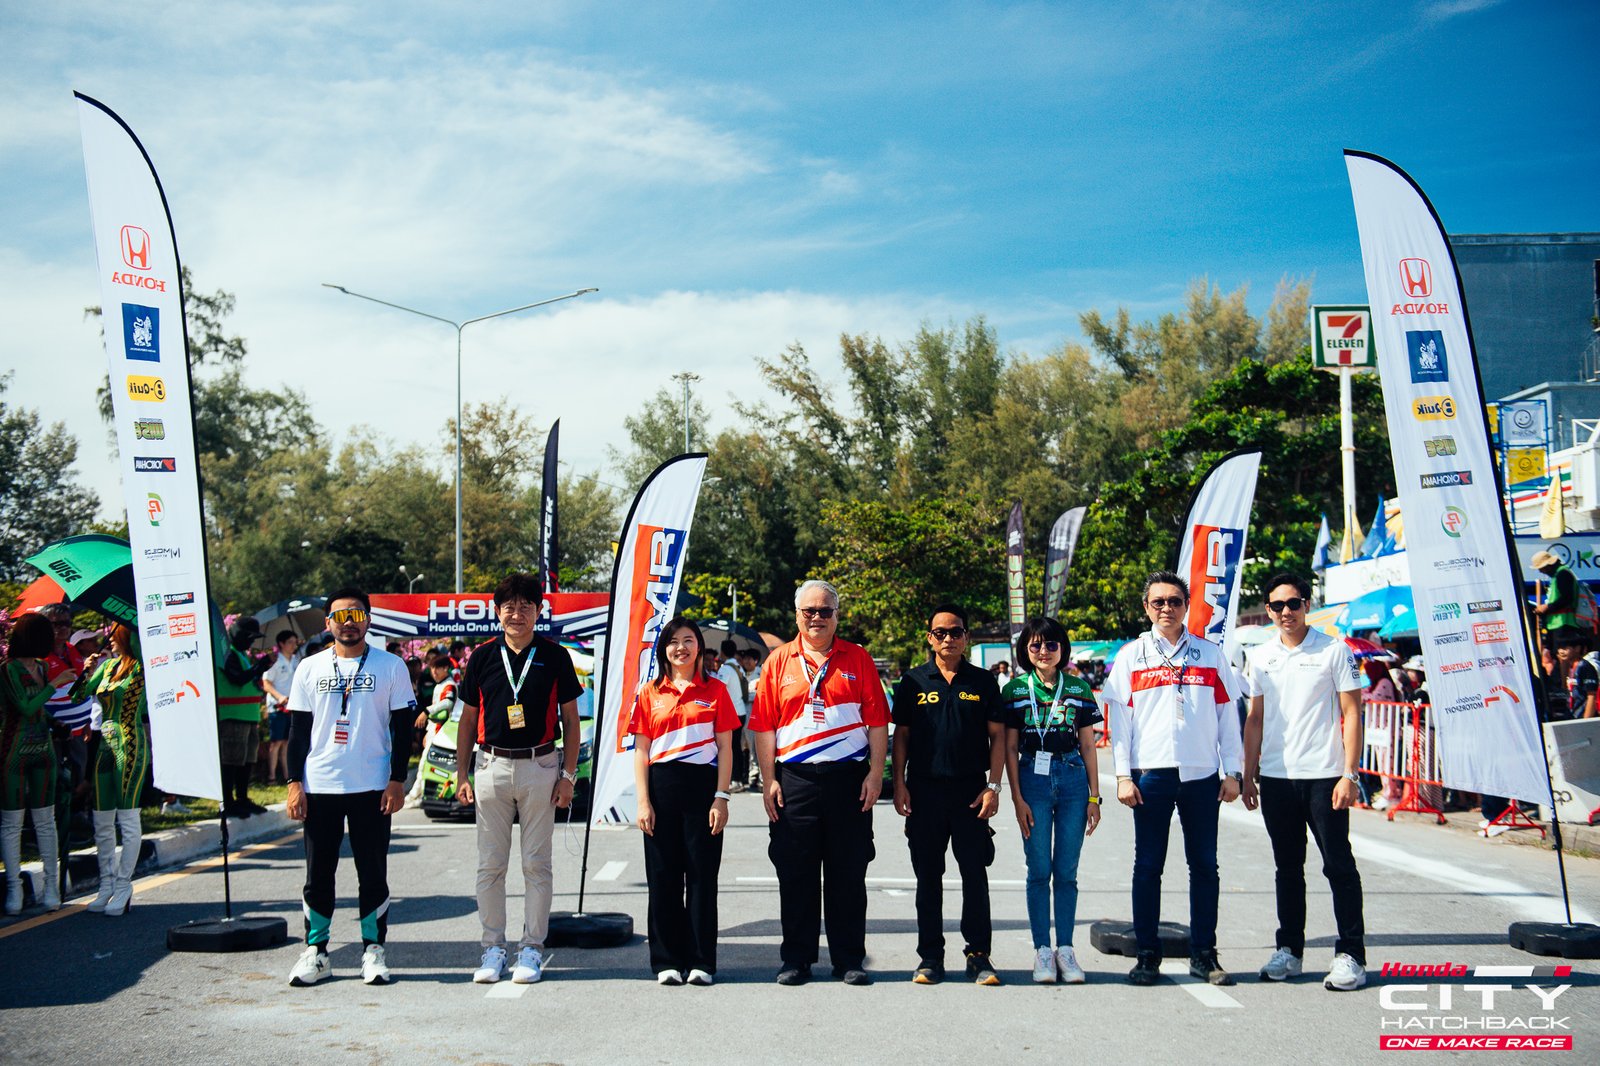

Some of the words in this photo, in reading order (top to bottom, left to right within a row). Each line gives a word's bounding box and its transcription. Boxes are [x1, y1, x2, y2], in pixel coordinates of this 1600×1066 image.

[48, 559, 83, 583] WISE
[1008, 554, 1025, 625] WISE
[102, 596, 138, 628] WIS
[429, 622, 466, 632] Honda
[466, 622, 489, 632] One
[917, 691, 940, 705] 26
[1024, 705, 1076, 726] WISE
